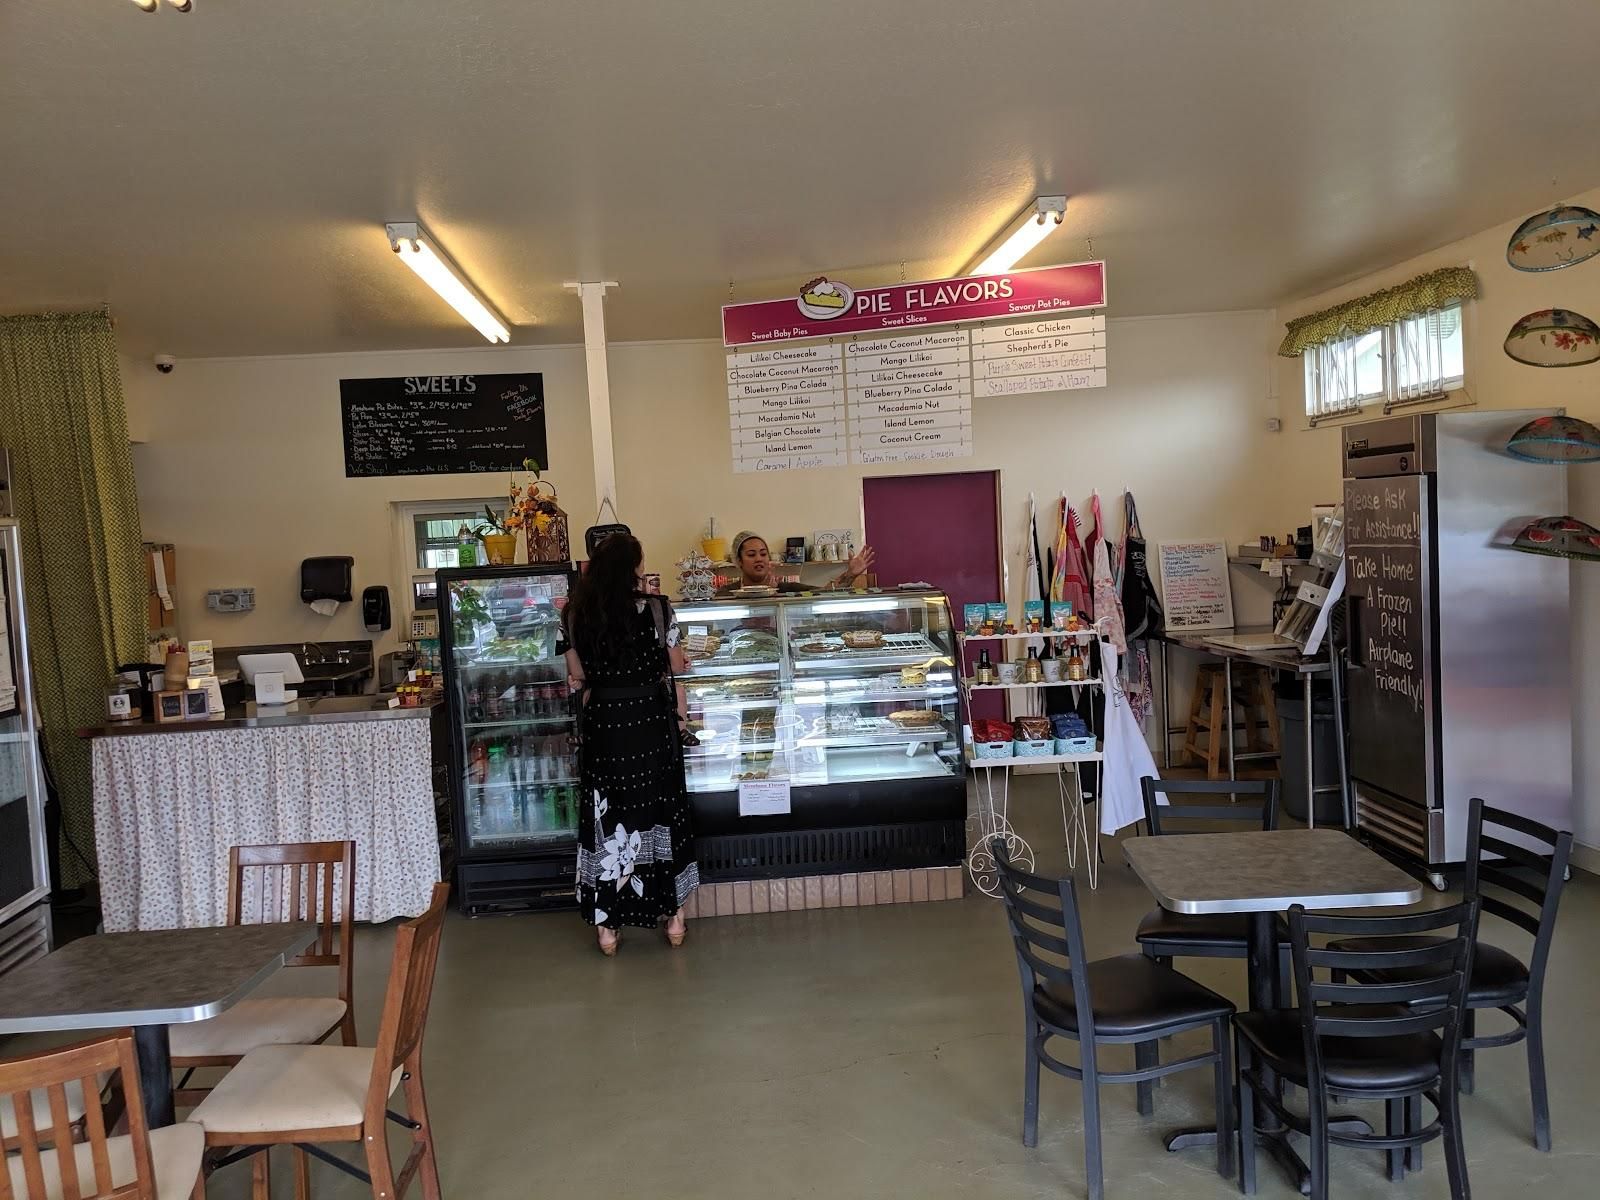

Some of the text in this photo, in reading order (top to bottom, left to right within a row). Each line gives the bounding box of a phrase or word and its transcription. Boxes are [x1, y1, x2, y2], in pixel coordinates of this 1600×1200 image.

[856, 278, 1014, 314] PIE FLAVORS
[1008, 298, 1070, 313] Savory Pot Pies
[882, 314, 928, 326] Sweet Slices
[752, 327, 808, 341] Sweet Baby Pies
[1004, 322, 1070, 337] Classic Chicken
[848, 335, 965, 353] Chocolate Coconut Macaroon
[1006, 338, 1068, 354] Shepherd's Pie
[750, 348, 817, 363] Lilikoi Cheesecake
[880, 354, 932, 367] Mango Lilikoi
[730, 364, 838, 380] Chocolate Coconut Macaroon
[871, 368, 943, 382] Lilikoi Cheesecake
[404, 376, 476, 394] SWEETS
[744, 385, 780, 395] Blueberry
[800, 379, 827, 389] Colada
[864, 388, 902, 399] Blueberry
[924, 382, 953, 392] Colada
[506, 394, 537, 412] FACEBOOK
[762, 396, 810, 409] Mango Lilikoi
[878, 400, 940, 413] Macadamia Nut
[758, 410, 816, 423] Macadamia Nut
[884, 418, 934, 428] Island Lemon
[754, 426, 821, 440] Belgian Chocolate
[880, 435, 912, 444] Coconut
[765, 444, 786, 453] Island
[469, 460, 486, 472] Box
[756, 458, 791, 471] Caramel
[1346, 488, 1381, 512] Please
[1347, 512, 1420, 543] For Assistance!!
[1382, 554, 1414, 580] Home
[1366, 584, 1412, 614] A Frozen
[1369, 638, 1414, 670] Airplane
[1375, 666, 1423, 714] Friendly!
